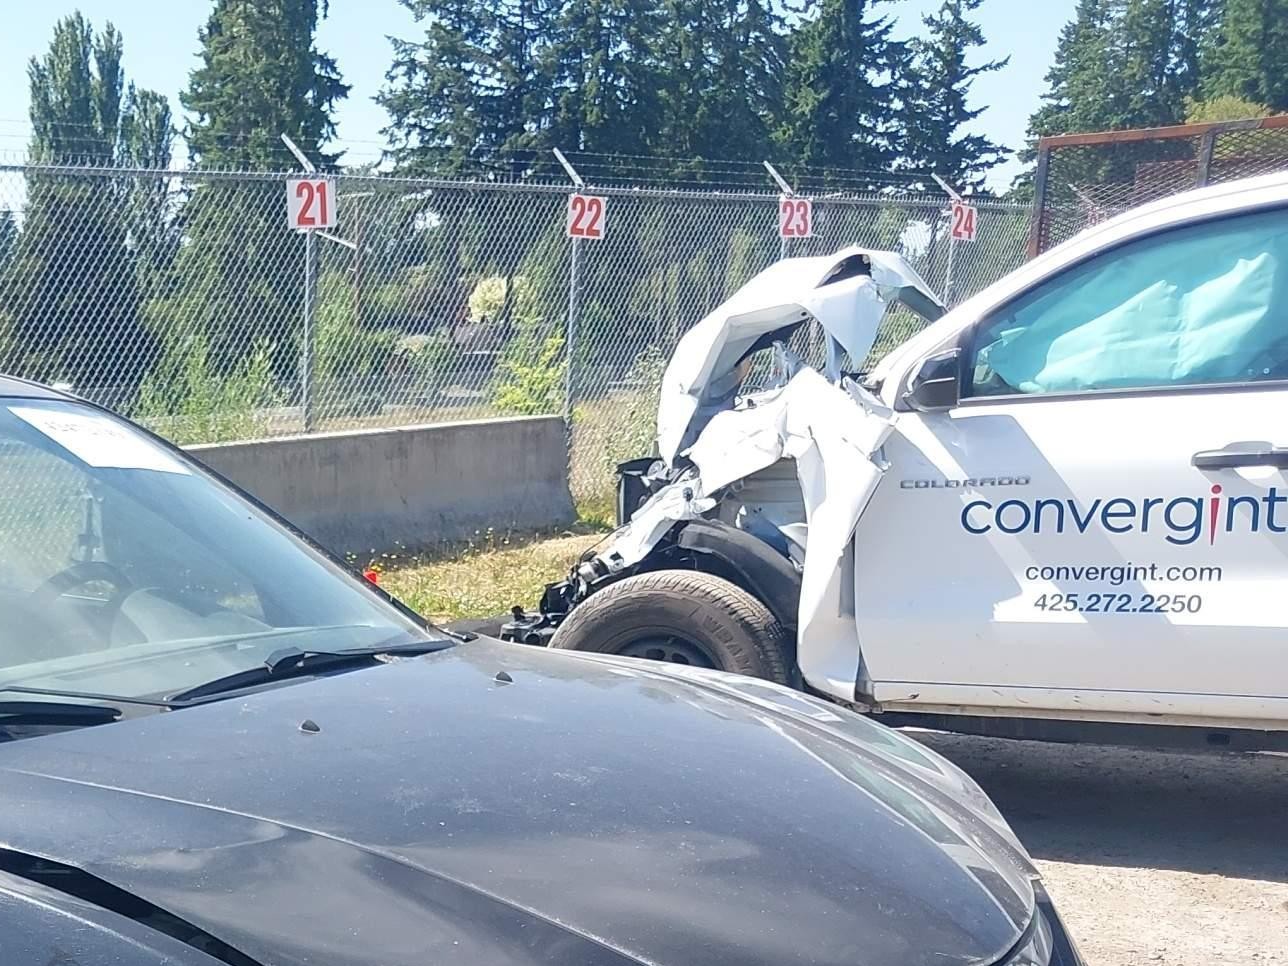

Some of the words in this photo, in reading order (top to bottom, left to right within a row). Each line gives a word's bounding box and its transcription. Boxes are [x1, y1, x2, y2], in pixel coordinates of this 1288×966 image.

[295, 181, 328, 226] 21
[570, 196, 602, 236] 22
[782, 200, 809, 236] 23
[952, 205, 974, 239] 24
[900, 476, 1032, 489] COLORADO
[960, 484, 1288, 547] convergint
[1025, 562, 1223, 586] convergint.com
[1034, 593, 1203, 614] 425.272.2250
